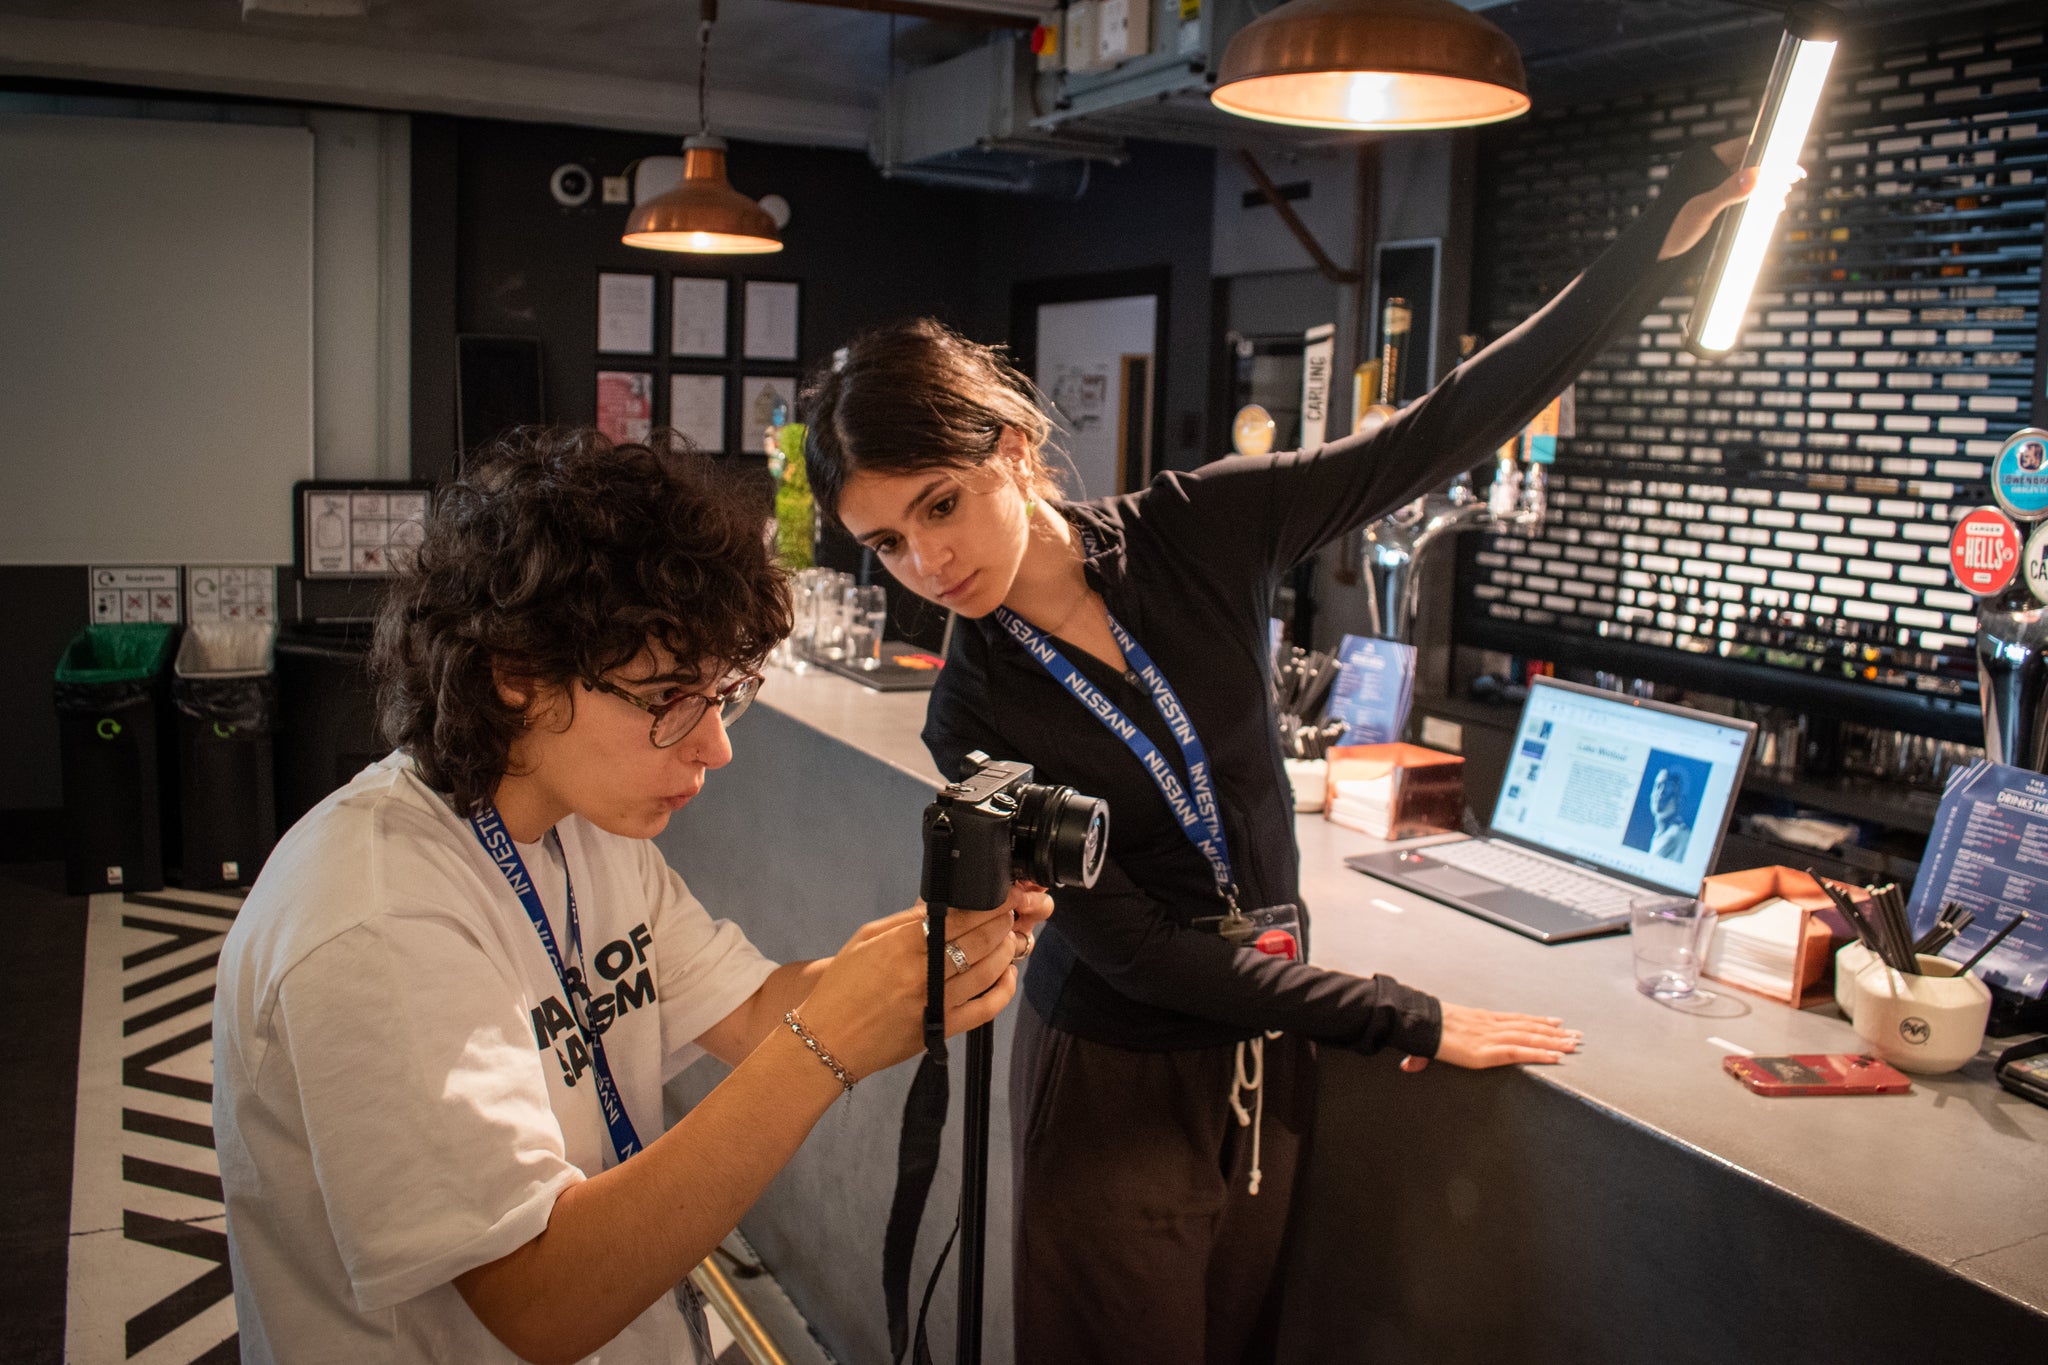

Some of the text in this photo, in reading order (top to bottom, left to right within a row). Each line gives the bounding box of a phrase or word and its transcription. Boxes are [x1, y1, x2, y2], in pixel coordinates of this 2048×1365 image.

[1306, 355, 1327, 422] CARLING
[1964, 536, 2004, 571] HELLS
[1064, 671, 1137, 740] INVESTIN
[1141, 665, 1196, 746] INVESTIN
[1143, 749, 1199, 827] INVESTIN
[1997, 791, 2035, 811] DRINKS
[1197, 838, 1230, 884] ESTIN
[594, 922, 653, 981] OF
